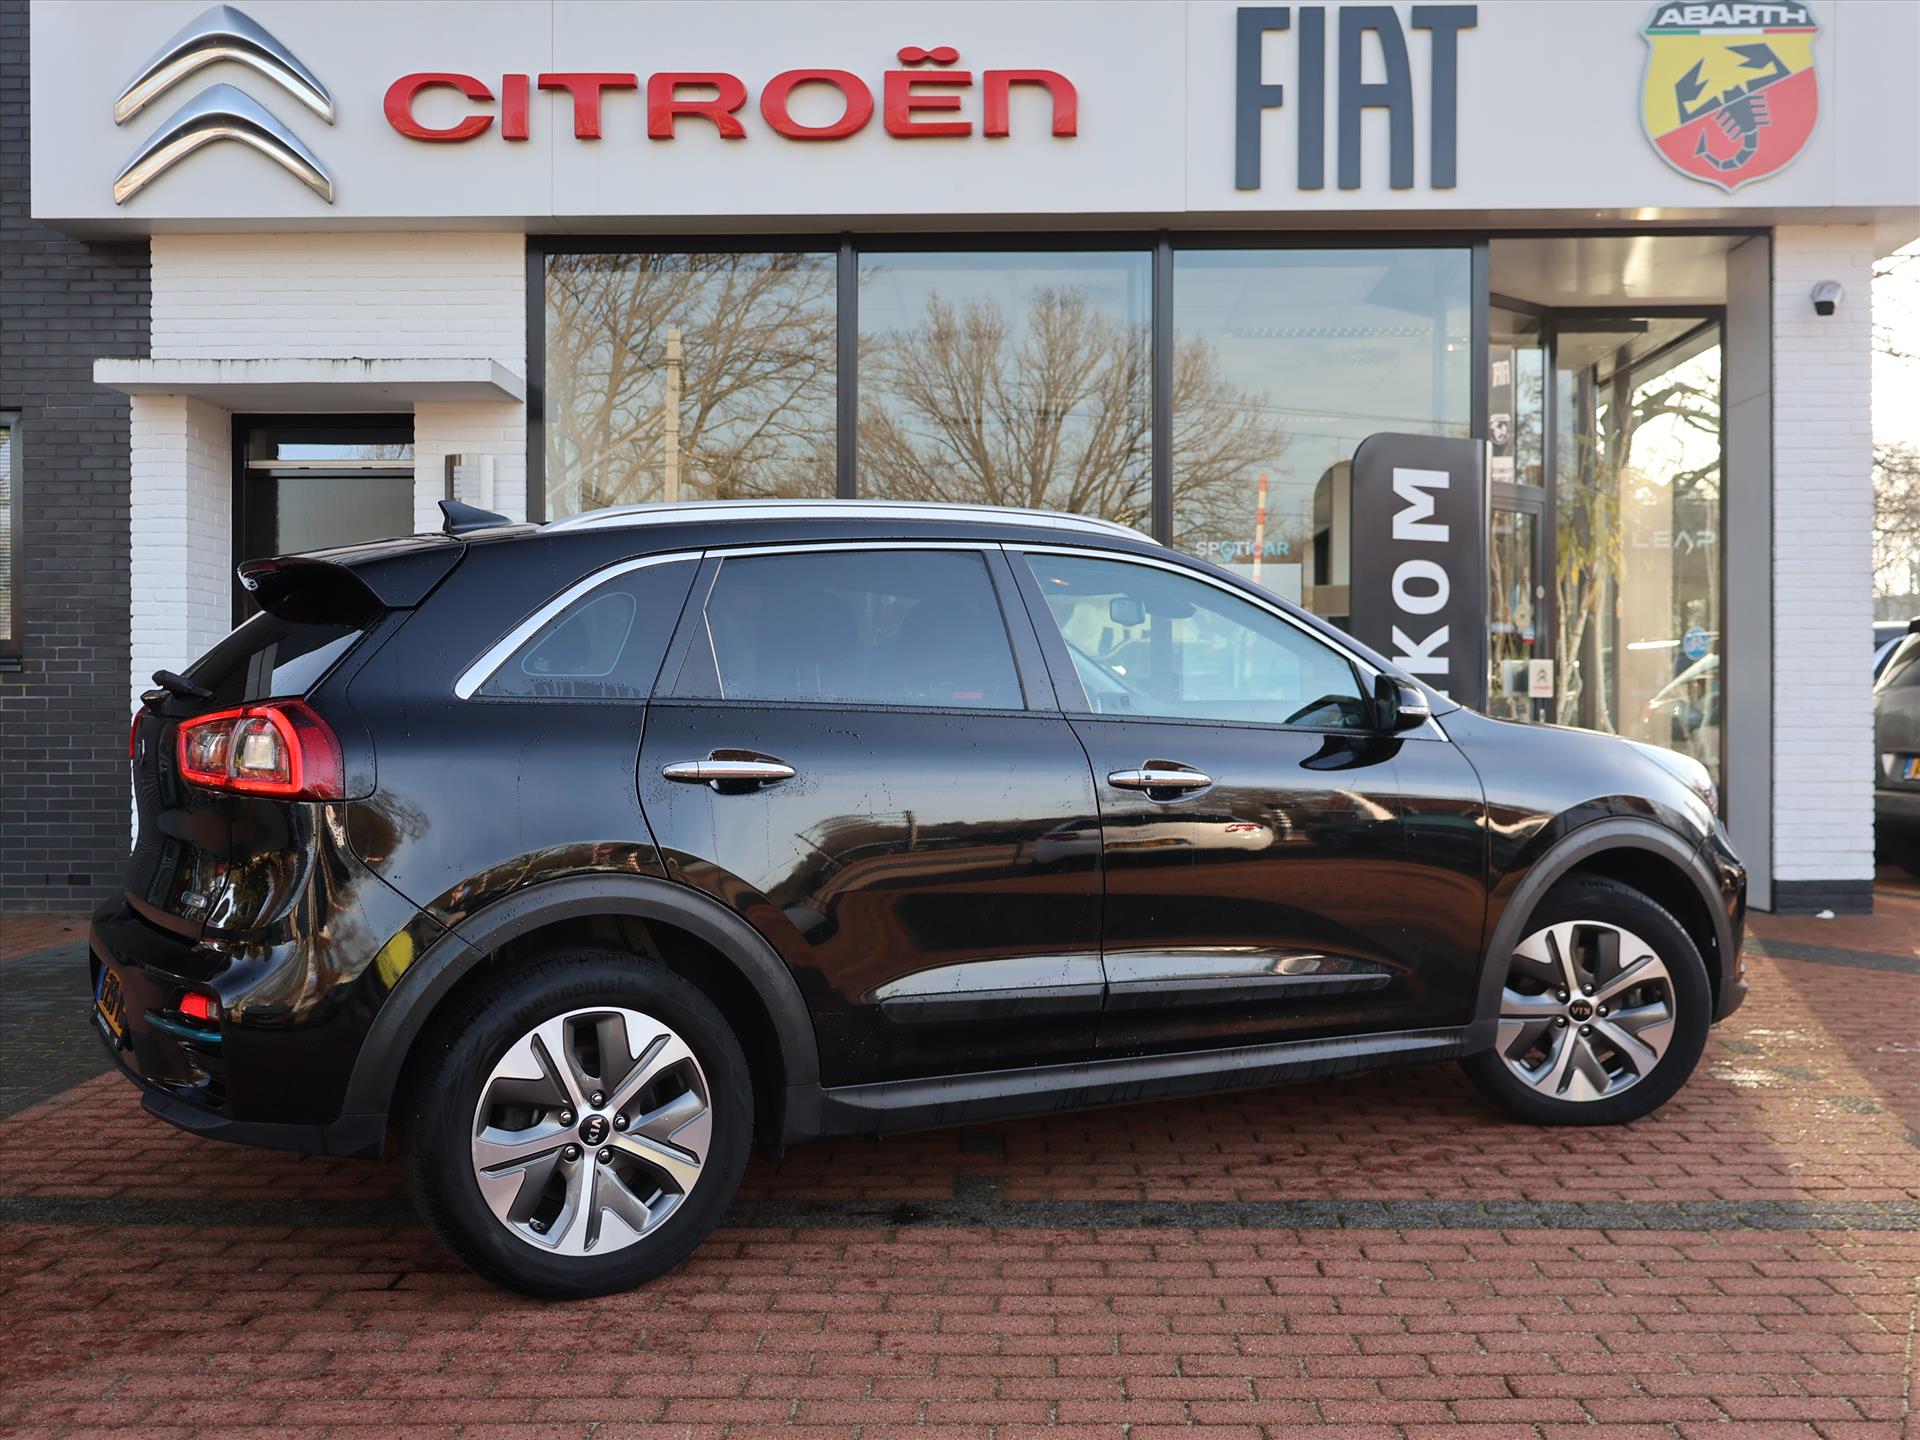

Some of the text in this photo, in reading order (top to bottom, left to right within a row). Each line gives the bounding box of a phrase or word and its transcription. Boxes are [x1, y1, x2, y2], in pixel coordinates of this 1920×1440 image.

[1657, 4, 1806, 25] ABARTH
[383, 46, 1078, 142] CITROËN
[1235, 5, 1478, 190] FIAT
[1391, 467, 1450, 698] KOM
[587, 1118, 603, 1144] KIA
